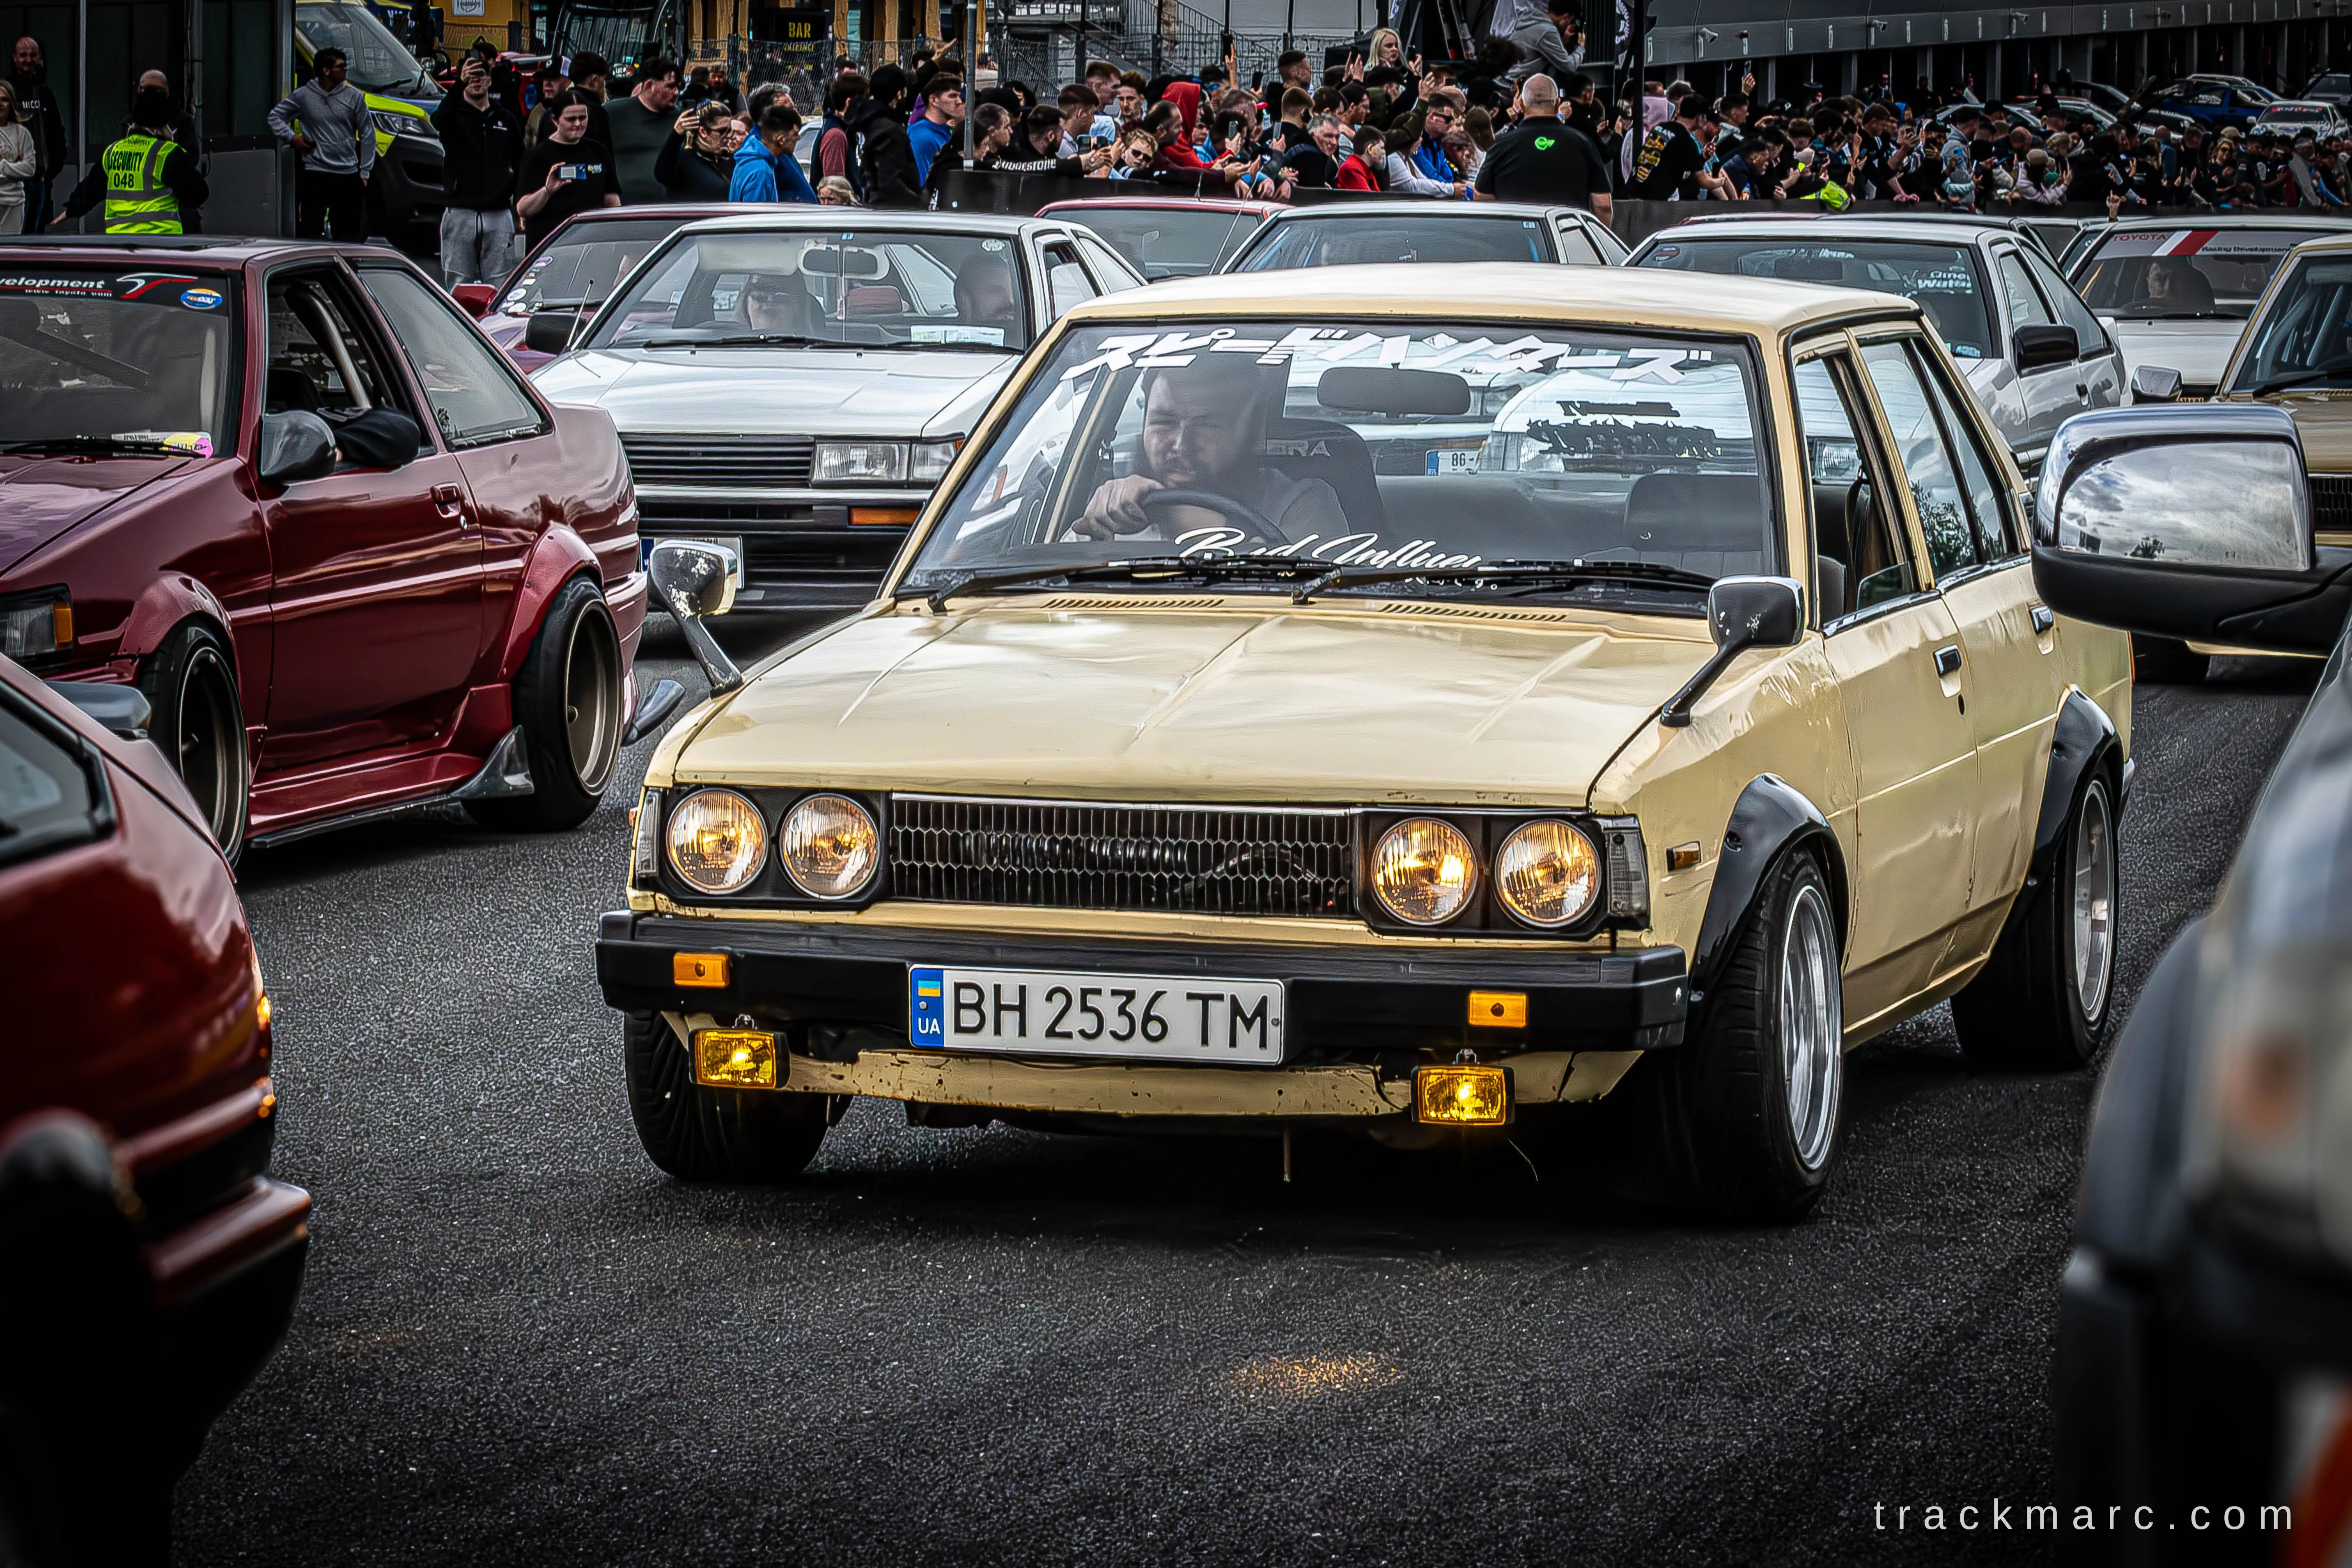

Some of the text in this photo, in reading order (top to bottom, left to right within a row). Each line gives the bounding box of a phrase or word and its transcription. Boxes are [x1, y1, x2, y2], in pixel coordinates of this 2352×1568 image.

[789, 22, 811, 38] BAR
[108, 150, 145, 172] SECURITY
[113, 172, 134, 188] 048
[2114, 233, 2166, 242] TOYOTA
[953, 980, 1269, 1050] BH 2536 TM
[918, 1017, 941, 1035] UA
